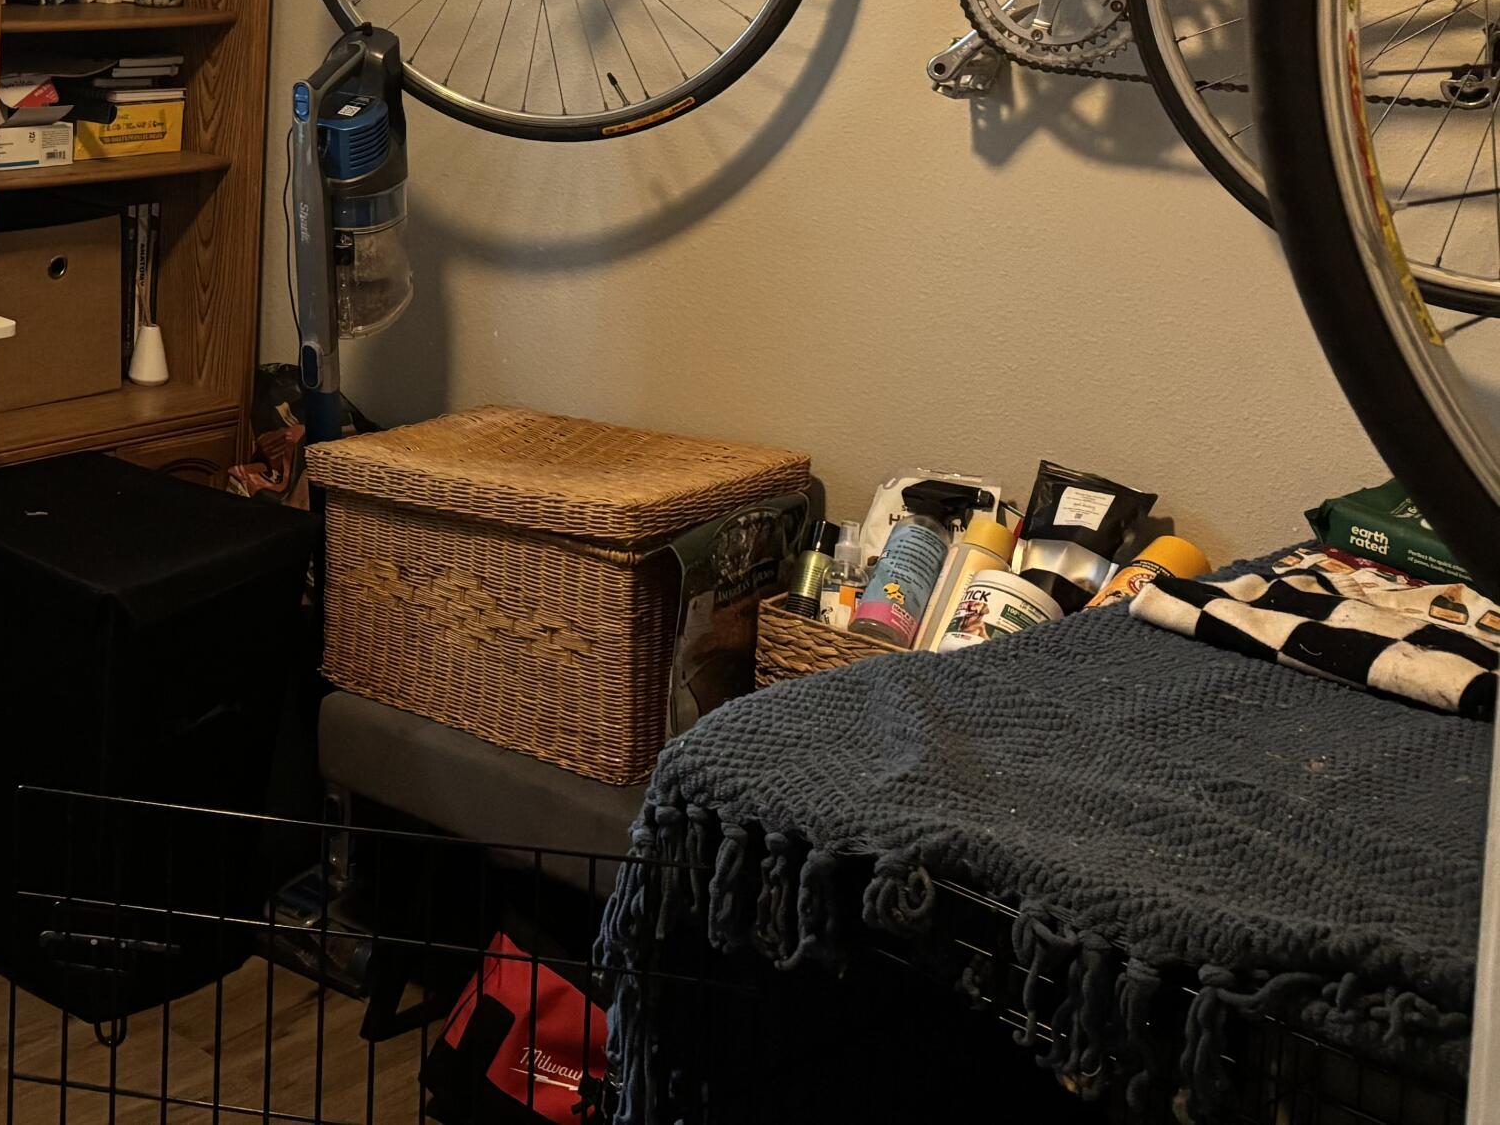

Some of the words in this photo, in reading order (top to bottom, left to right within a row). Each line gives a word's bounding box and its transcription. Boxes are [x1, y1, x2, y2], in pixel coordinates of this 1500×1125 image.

[1349, 534, 1388, 556] rated
[1351, 525, 1389, 545] earth
[519, 1046, 584, 1080] Milwau
